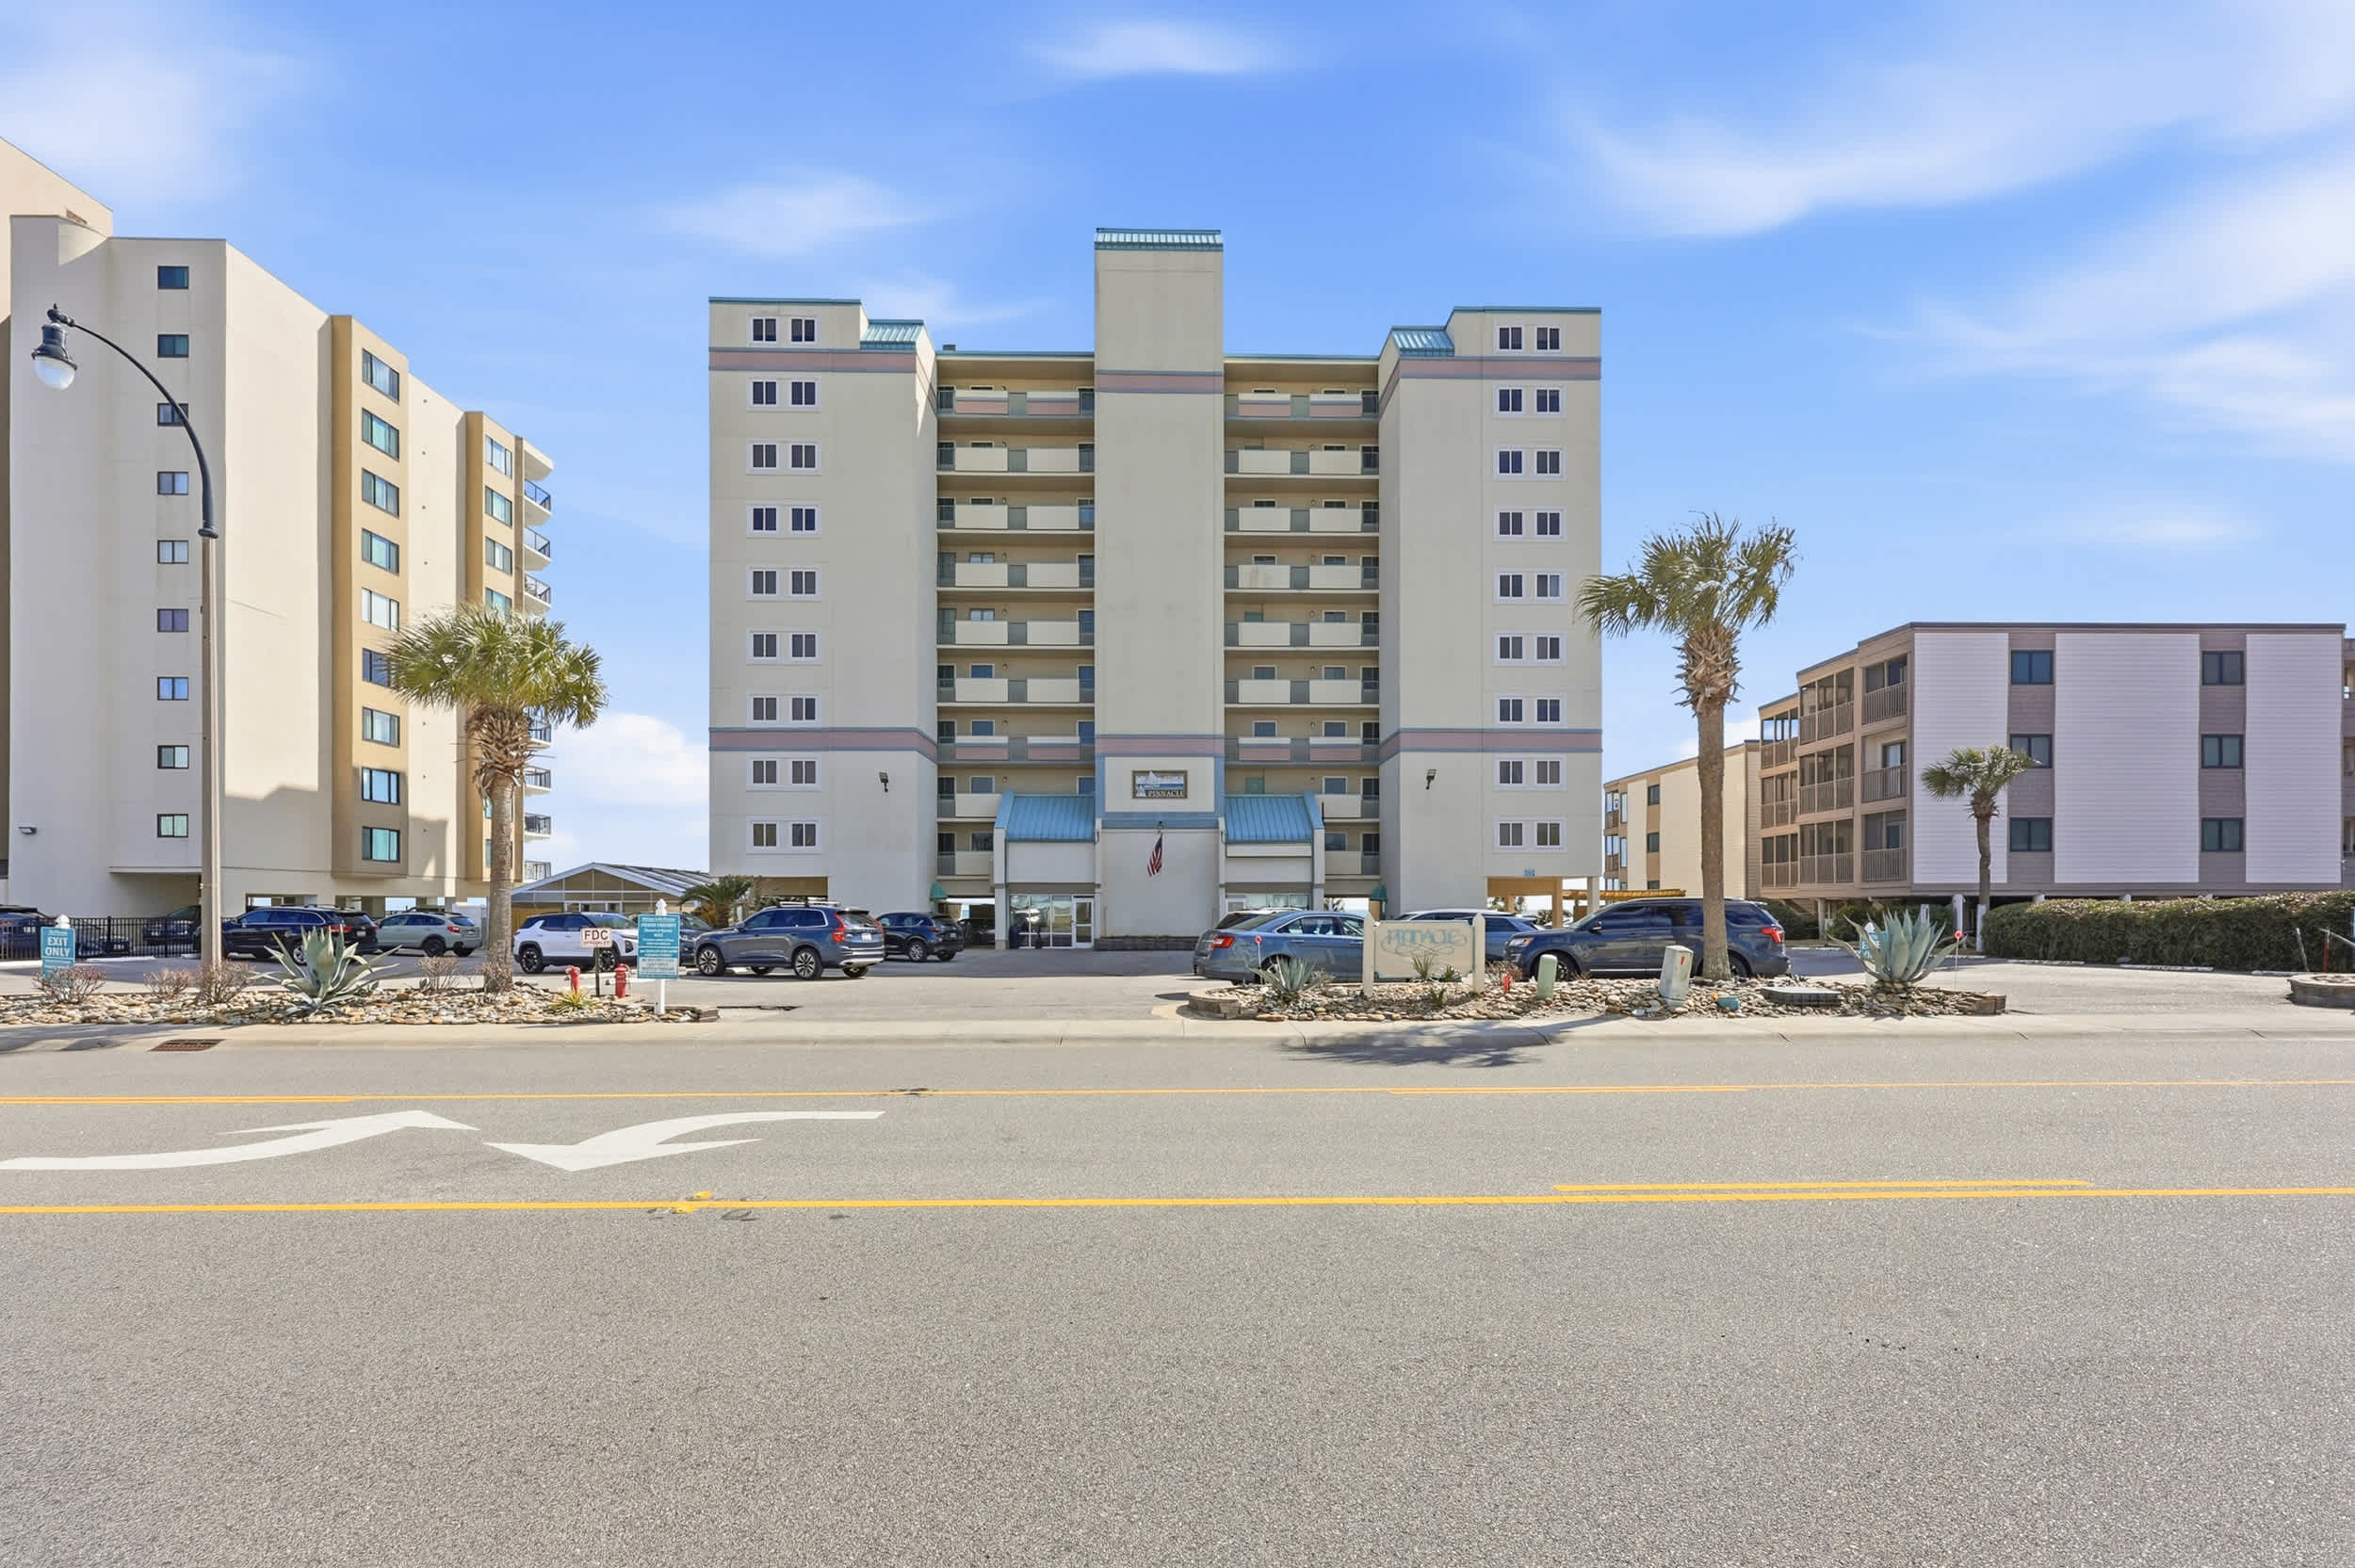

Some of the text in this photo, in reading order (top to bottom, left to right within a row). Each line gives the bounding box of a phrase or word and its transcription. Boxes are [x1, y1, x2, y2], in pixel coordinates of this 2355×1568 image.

[584, 929, 609, 940] FDC
[47, 936, 68, 947] EXIT
[44, 946, 71, 957] ONLY
